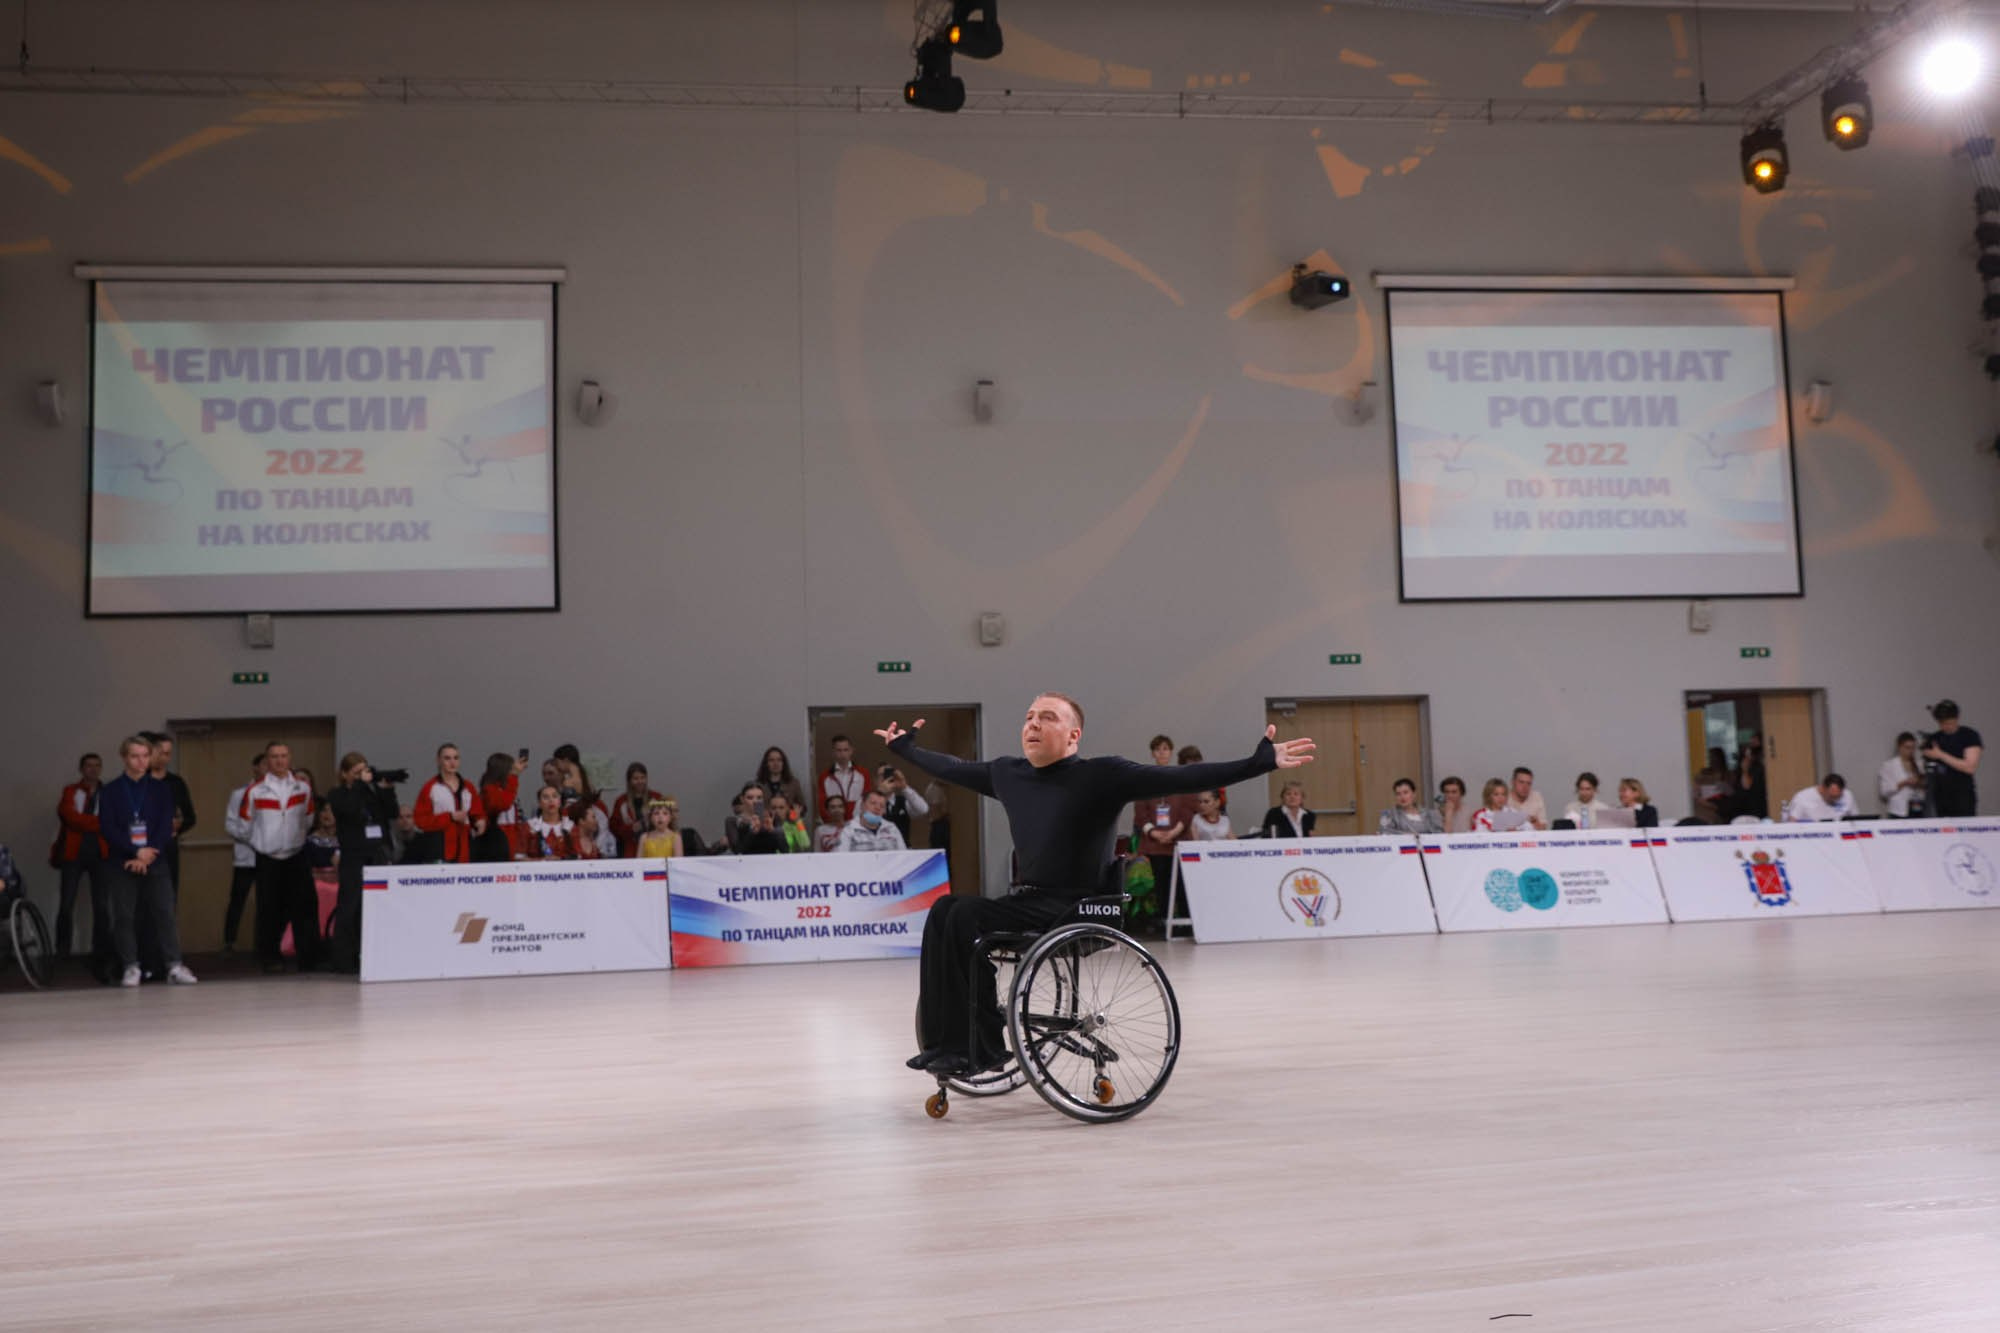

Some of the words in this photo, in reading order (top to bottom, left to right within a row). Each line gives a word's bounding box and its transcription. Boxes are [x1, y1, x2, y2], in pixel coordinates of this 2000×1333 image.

[131, 345, 495, 385] ЧЕМПИОНАТ
[1427, 349, 1731, 383] ЧЕМПИОНАТ
[200, 396, 428, 434] РОССИИ
[1487, 395, 1679, 429] РОССИИ
[265, 448, 366, 477] 2022
[1544, 442, 1629, 467] 2022
[214, 488, 264, 512] ПО
[270, 487, 414, 512] ТАНЦАМ
[1505, 479, 1544, 500] ПО
[1550, 477, 1671, 500] ТАНЦАМ
[1492, 510, 1531, 531] НА
[1537, 508, 1688, 530] КОЛЯСКАХ
[197, 523, 246, 547] НА
[252, 520, 432, 546] КОЛЯСКАХ
[397, 877, 456, 886] ЧЕМПИОНАТ
[458, 875, 494, 884] РОССИИ
[495, 874, 517, 884] 2022
[519, 873, 532, 882] ПО
[534, 872, 572, 883] ТАНЦАМ
[573, 871, 586, 880] НА
[587, 870, 634, 880] КОЛЯСКАХ
[718, 883, 831, 902] ЧЕМПИОНАТ
[835, 880, 904, 898] РОССИИ
[796, 905, 832, 919] 2022
[1079, 904, 1121, 916] LUKOR
[492, 923, 525, 932] ФОНД
[492, 932, 586, 943] ПРЕЗИДЕНТСКИХ
[721, 928, 742, 943] ПО
[746, 924, 807, 942] ТАНЦАМ
[810, 923, 830, 938] НА
[833, 921, 908, 938] КОЛЯСКАХ
[491, 944, 542, 954] ГРАНТОВ
